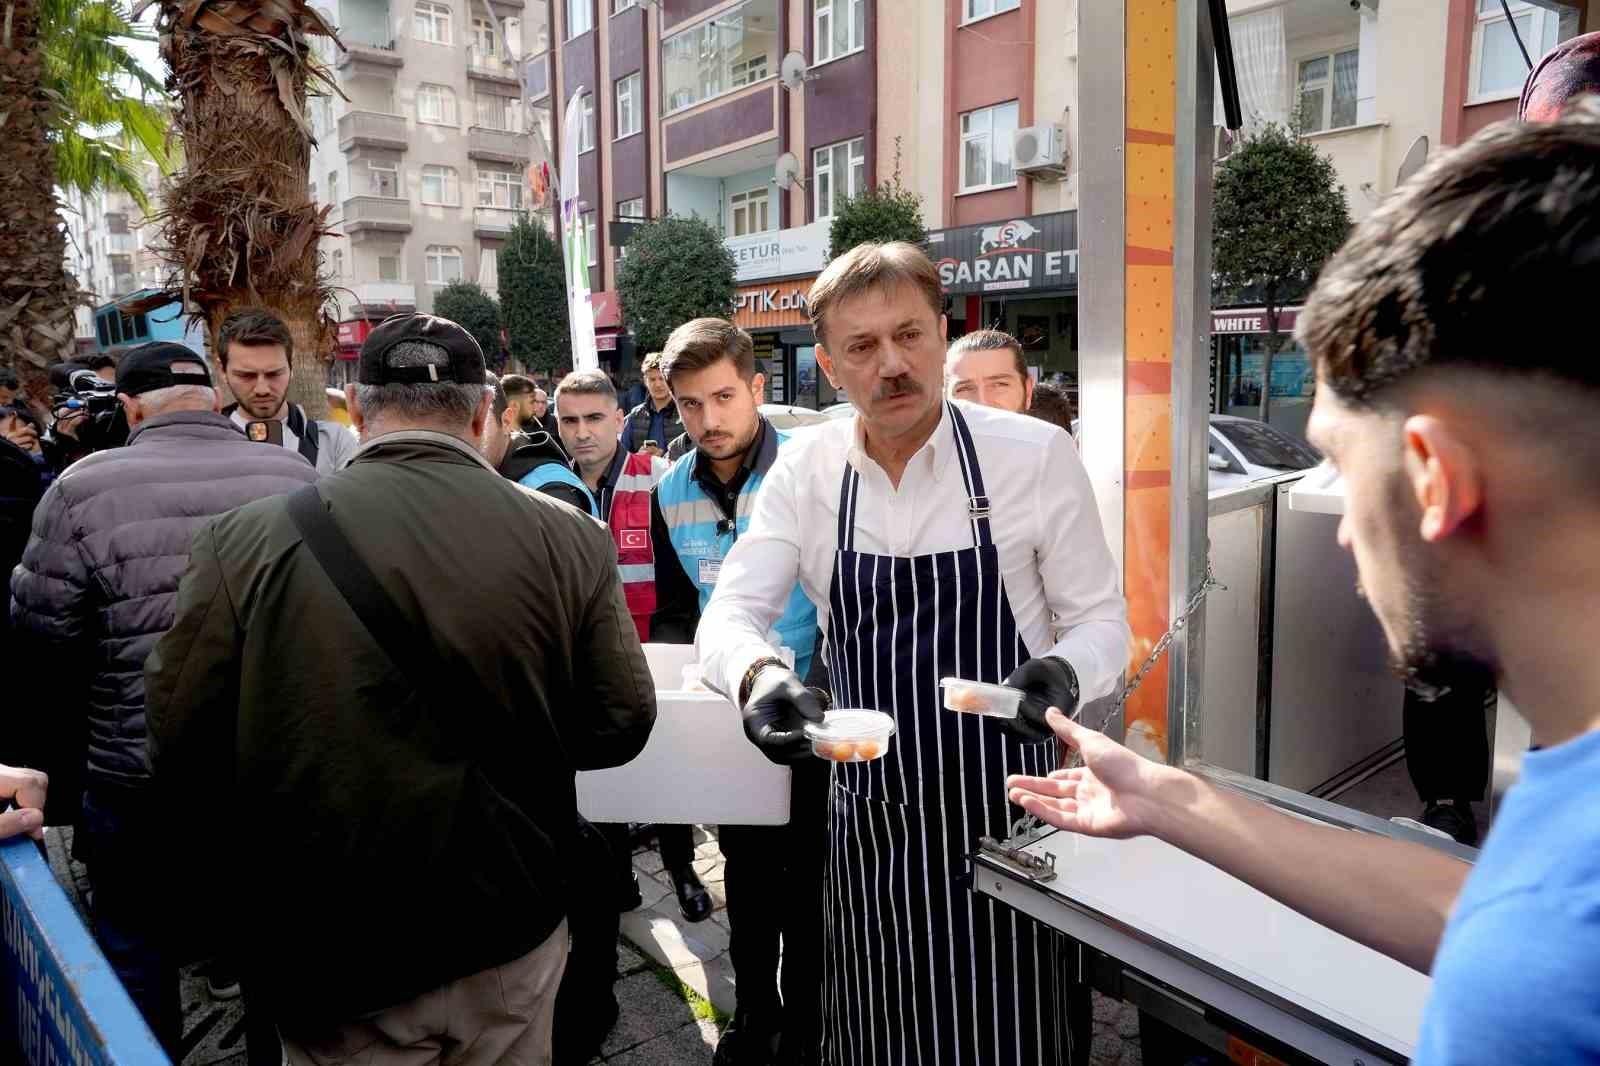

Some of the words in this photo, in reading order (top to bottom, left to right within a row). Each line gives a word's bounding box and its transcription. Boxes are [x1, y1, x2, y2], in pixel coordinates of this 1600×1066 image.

[1004, 228, 1015, 240] S
[939, 254, 1033, 286] SARAN
[1046, 249, 1078, 275] ET
[1214, 318, 1262, 331] WHITE
